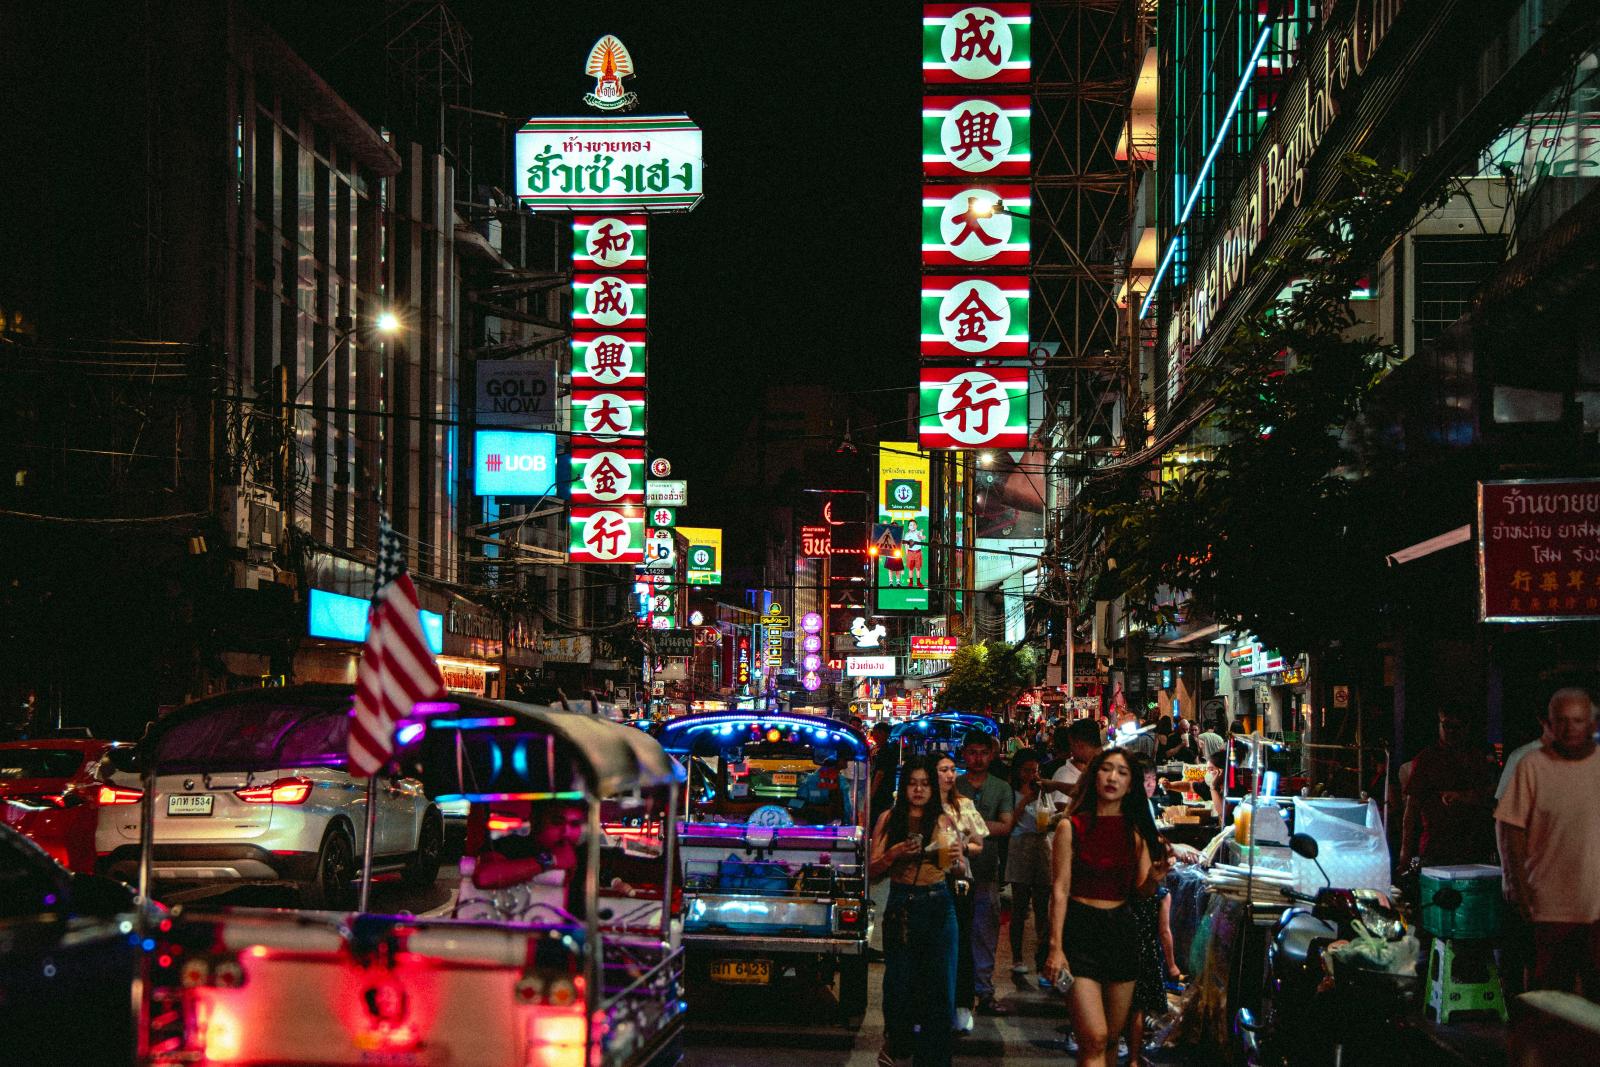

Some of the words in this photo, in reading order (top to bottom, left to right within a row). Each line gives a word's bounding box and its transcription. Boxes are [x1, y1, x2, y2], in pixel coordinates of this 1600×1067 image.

[562, 136, 651, 153] ห้างขายทอง
[526, 144, 693, 192] ฮั่วเซ่งเฮง
[1190, 245, 1221, 353] Hotel
[1223, 165, 1265, 300] Royal
[1268, 38, 1339, 221] Bangkok
[486, 379, 547, 397] GOLD
[494, 397, 540, 413] NOW
[505, 455, 547, 472] UOB
[191, 797, 211, 806] 1534
